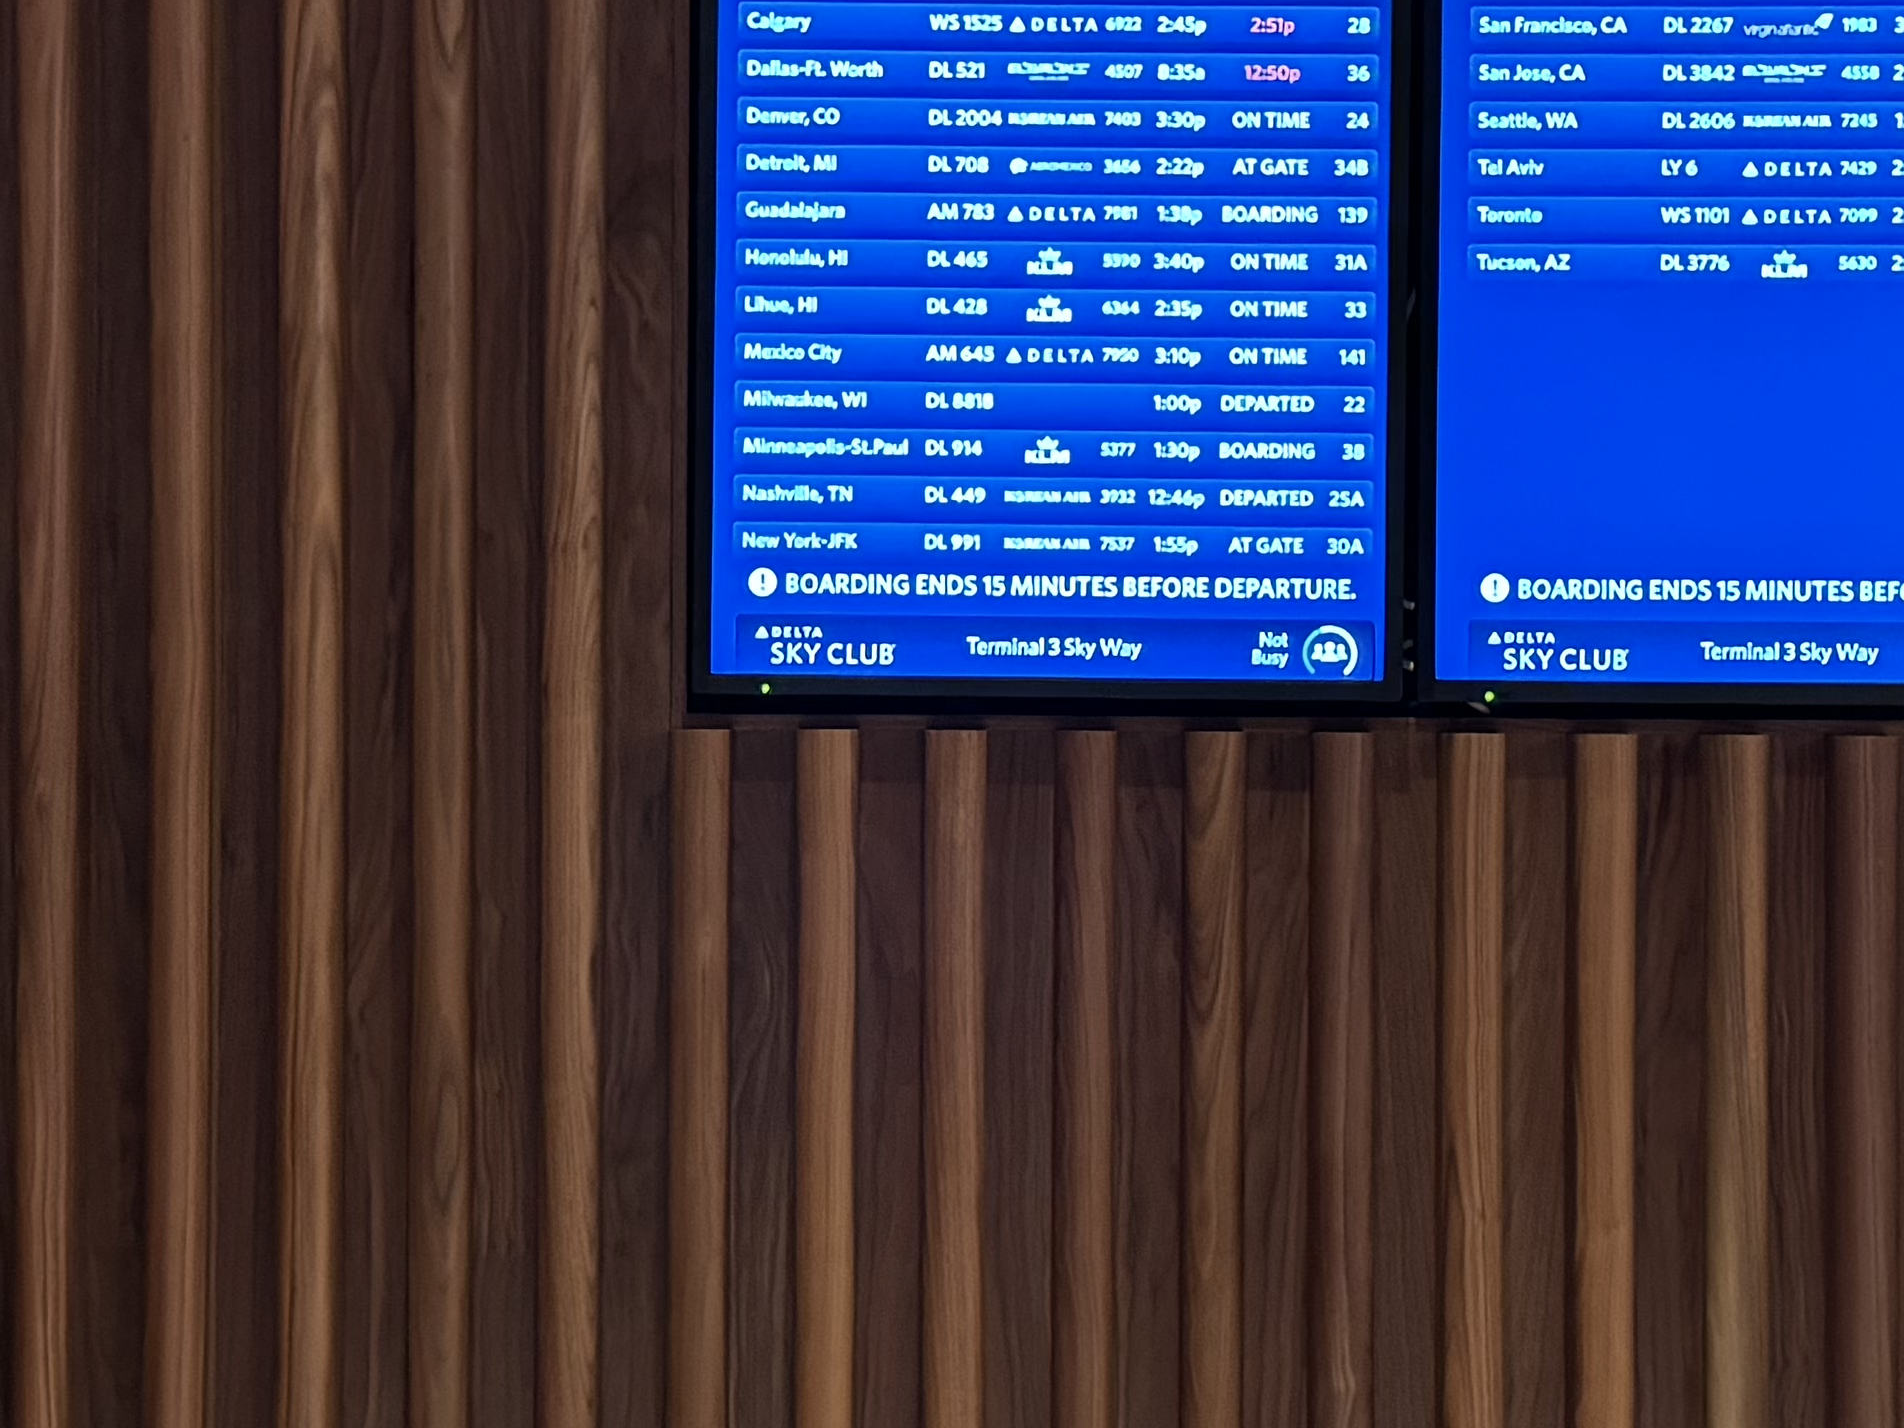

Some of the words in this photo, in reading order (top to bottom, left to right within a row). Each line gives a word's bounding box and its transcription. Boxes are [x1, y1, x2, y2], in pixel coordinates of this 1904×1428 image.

[746, 11, 812, 33] Calgary
[929, 13, 961, 31] WS
[962, 14, 1003, 32] 1525
[1157, 15, 1207, 37] 2:45p
[1250, 16, 1296, 37] 2:51p
[746, 106, 810, 127] Denver,
[812, 107, 841, 125] CO
[928, 108, 953, 126] DL
[955, 108, 1003, 127] 2004
[1155, 110, 1206, 132] 3:30p
[1231, 111, 1261, 129] ON
[1264, 111, 1311, 129] TIME
[1346, 112, 1370, 129] 24
[1477, 158, 1503, 176] Tel
[1505, 158, 1544, 176] Aviv
[1661, 158, 1683, 176] LY
[1685, 159, 1698, 177] 6
[1764, 161, 1833, 177] DELTA
[1476, 205, 1543, 223] Toronto
[1660, 206, 1692, 224] WS
[1694, 206, 1730, 224] 1101
[743, 342, 805, 360] Mexico
[807, 343, 842, 364] City
[925, 344, 958, 362] AM
[960, 345, 995, 363] 645
[1154, 346, 1202, 368] 3:10p
[1228, 346, 1258, 365] ON
[1261, 347, 1308, 365] TIME
[1339, 349, 1366, 366] 141
[742, 531, 780, 549] New
[783, 532, 858, 549] York-JFK
[924, 533, 948, 551] DL
[950, 534, 981, 551] 991
[1153, 536, 1199, 557] 1:55p
[1228, 536, 1253, 554] AT
[1256, 536, 1304, 555] GATE
[1327, 537, 1365, 555] 30A
[785, 572, 910, 596] BOARDING
[915, 573, 978, 597] ENDS
[982, 575, 1006, 597] 15
[1010, 574, 1119, 598] MINUTES
[1122, 576, 1210, 599] BEFORE
[1214, 576, 1357, 600] DEPARTURE.
[1517, 578, 1643, 601] BOARDING
[1649, 579, 1713, 602] ENDS
[1716, 580, 1741, 602] 15
[1745, 579, 1855, 602] MINUTES
[771, 625, 823, 639] DELTA
[1258, 631, 1289, 648] Not
[1503, 631, 1556, 644] DELTA
[770, 641, 822, 665] SKY
[966, 635, 1045, 656] Terminal
[1048, 637, 1061, 657] 3
[1063, 637, 1097, 661] Sky
[1099, 637, 1143, 661] Way
[1251, 648, 1289, 669] Busy
[1503, 647, 1554, 671] SKY
[1700, 641, 1781, 661] Terminal
[1783, 642, 1796, 662] 3
[1799, 641, 1833, 665] Sky
[1835, 642, 1880, 666] Way
